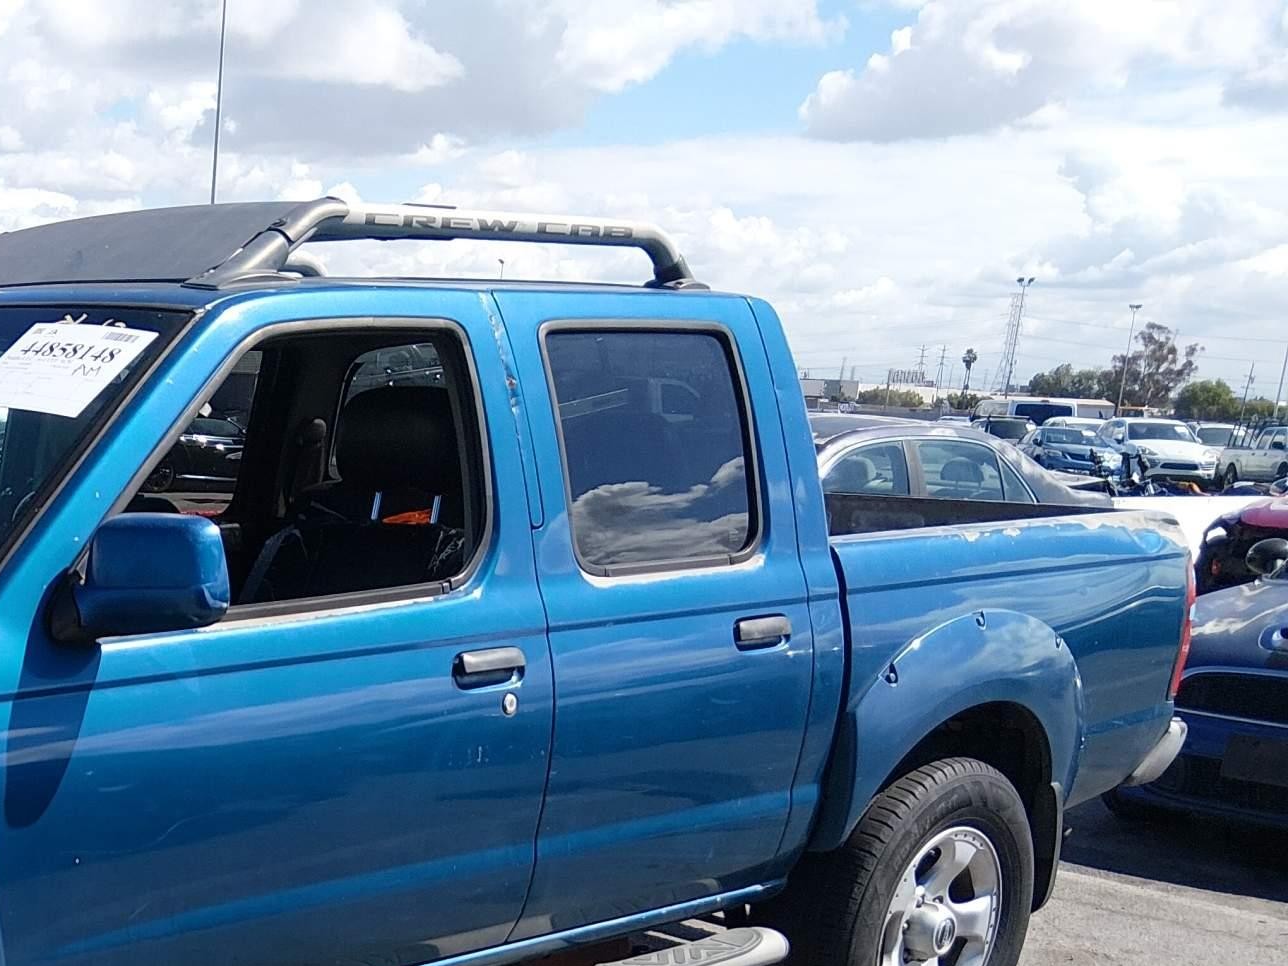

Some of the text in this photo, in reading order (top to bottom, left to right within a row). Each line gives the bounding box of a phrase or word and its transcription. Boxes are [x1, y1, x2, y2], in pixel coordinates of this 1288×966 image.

[365, 212, 634, 238] CREW CAB
[20, 340, 123, 364] 44858148
